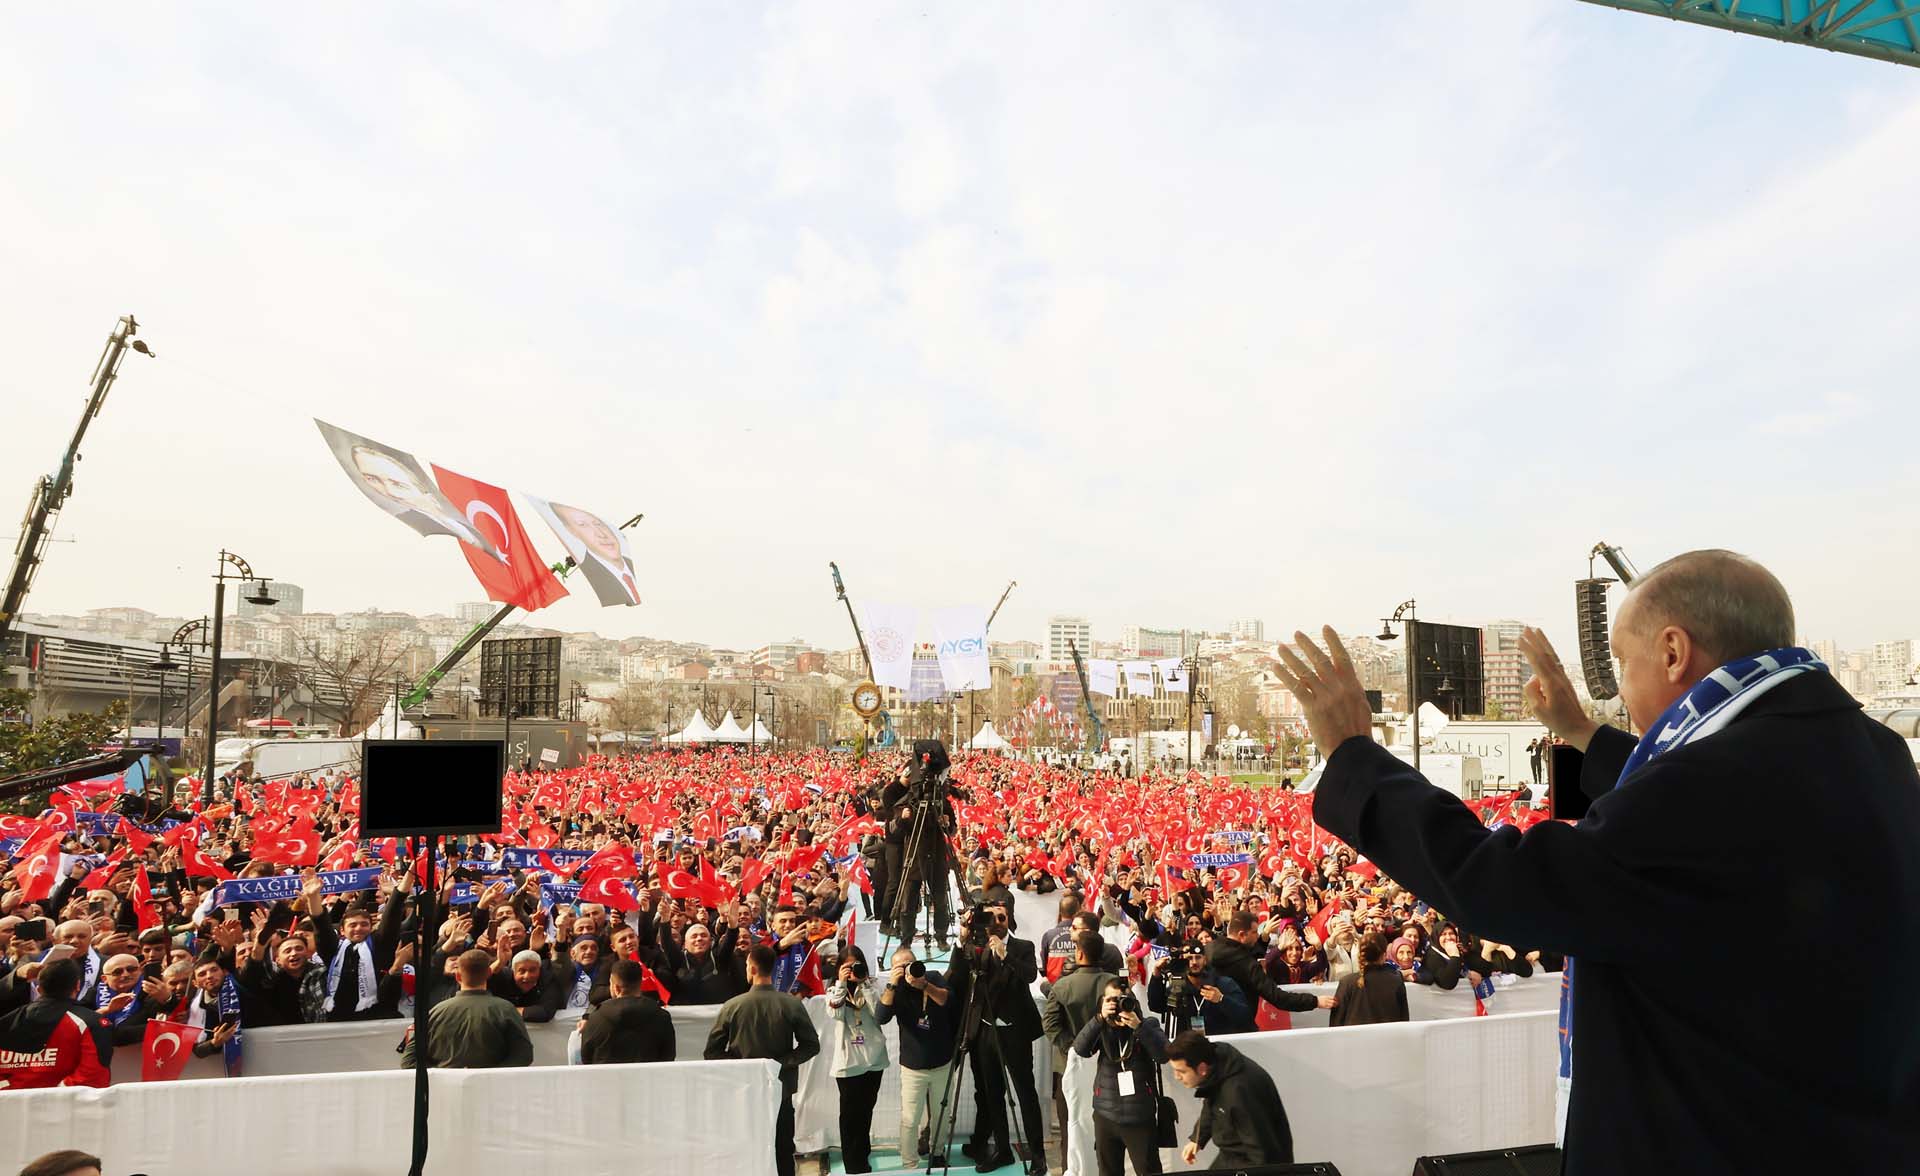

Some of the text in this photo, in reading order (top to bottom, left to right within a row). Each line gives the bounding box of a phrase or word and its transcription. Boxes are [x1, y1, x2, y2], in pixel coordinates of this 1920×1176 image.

[238, 872, 358, 895] KAĞITANE
[1057, 940, 1077, 950] UMK
[0, 1047, 59, 1064] UMKE
